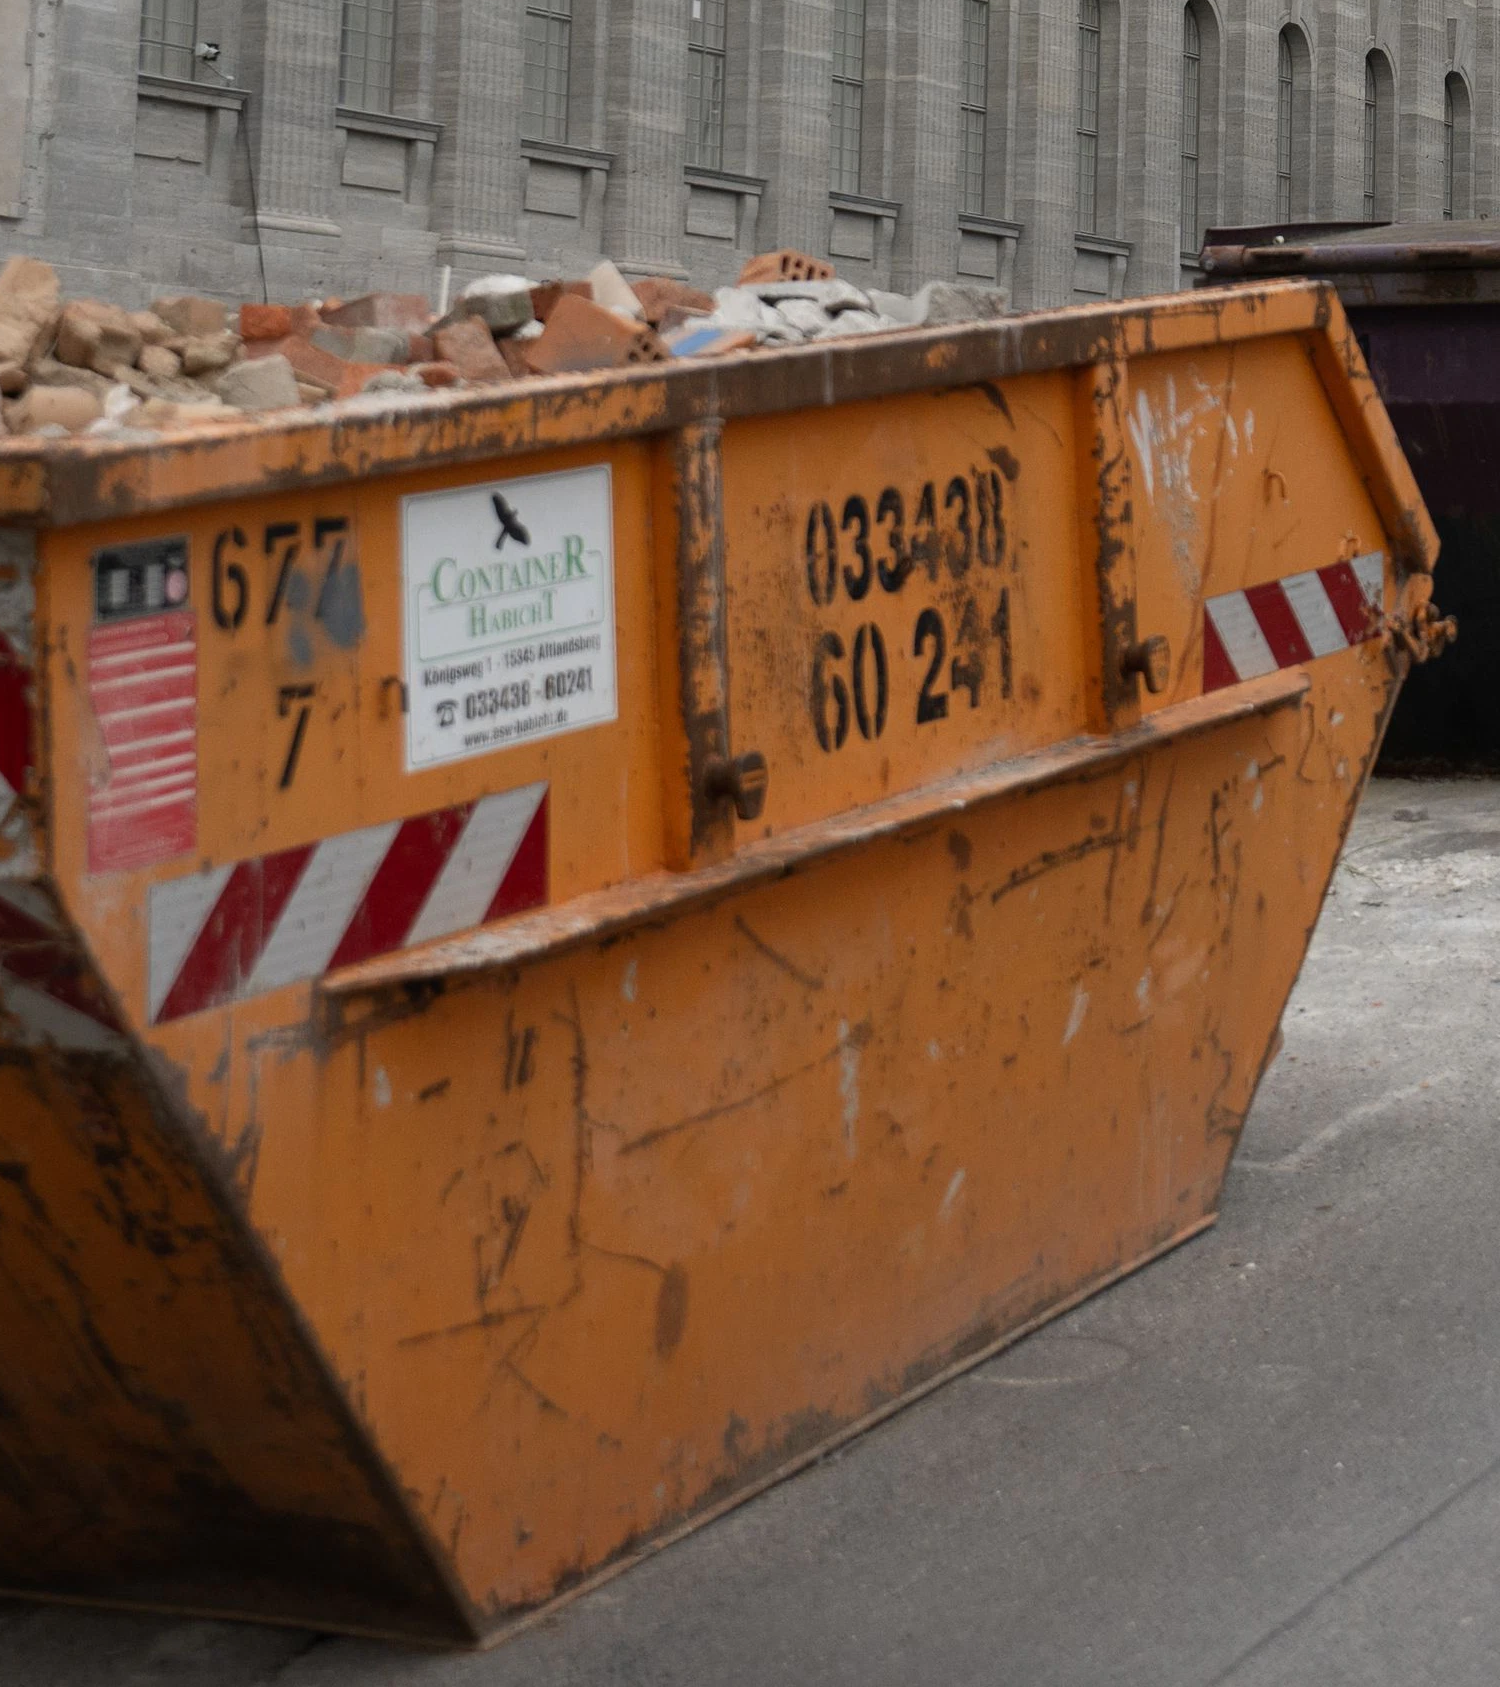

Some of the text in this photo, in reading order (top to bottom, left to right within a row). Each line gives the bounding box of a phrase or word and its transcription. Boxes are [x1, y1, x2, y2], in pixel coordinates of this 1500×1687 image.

[212, 518, 347, 630] 677
[432, 534, 588, 602] CONTAINER
[806, 469, 1007, 607] 033438
[470, 590, 557, 638] HABICHT
[424, 657, 484, 687] Königsweg
[539, 633, 602, 661] Altlandsberg
[465, 679, 531, 720] 033438
[545, 665, 593, 701] 60241
[811, 585, 1013, 753] 60 241
[277, 684, 315, 791] 7
